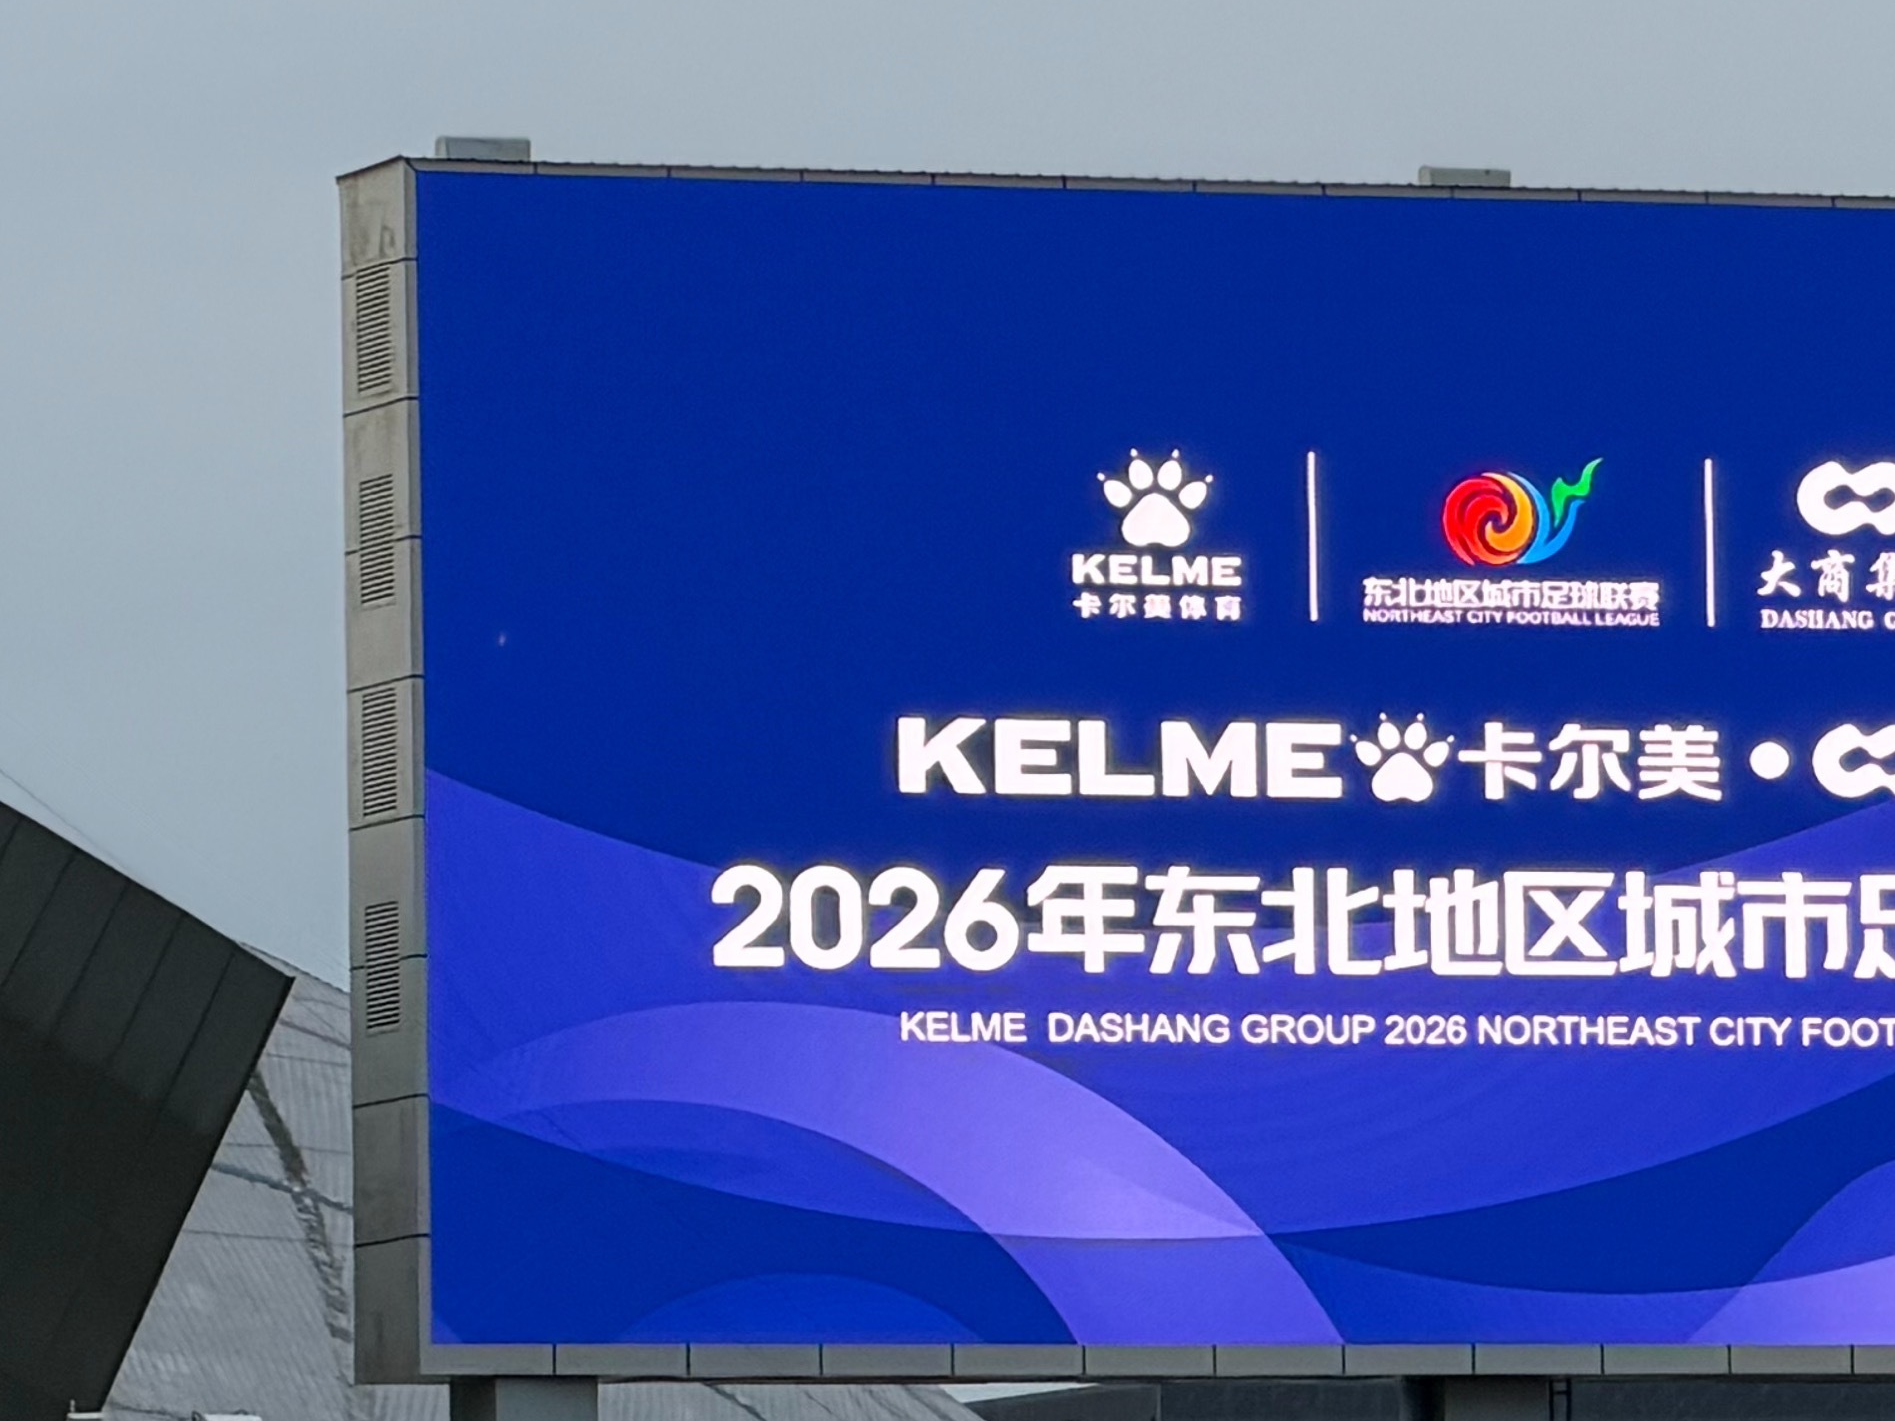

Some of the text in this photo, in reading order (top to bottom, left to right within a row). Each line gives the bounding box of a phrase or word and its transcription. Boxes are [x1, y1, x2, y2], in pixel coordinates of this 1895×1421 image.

[1072, 553, 1242, 587] KELME
[1362, 576, 1660, 610] 东北地区城市足球联赛
[1363, 608, 1660, 627] NORTHEAST CITY FOOTBALL LEAGUE
[1760, 608, 1875, 630] DASHANG
[897, 715, 1344, 803] KELME
[1457, 720, 1723, 803] 卡尔美
[900, 1010, 1028, 1043] KELME
[1048, 1011, 1231, 1044] DASHANG
[1240, 1013, 1376, 1046] GROUP
[1384, 1013, 1468, 1046] 2026
[1477, 1014, 1702, 1047] NORTHEAST
[1708, 1015, 1793, 1048] CITY
